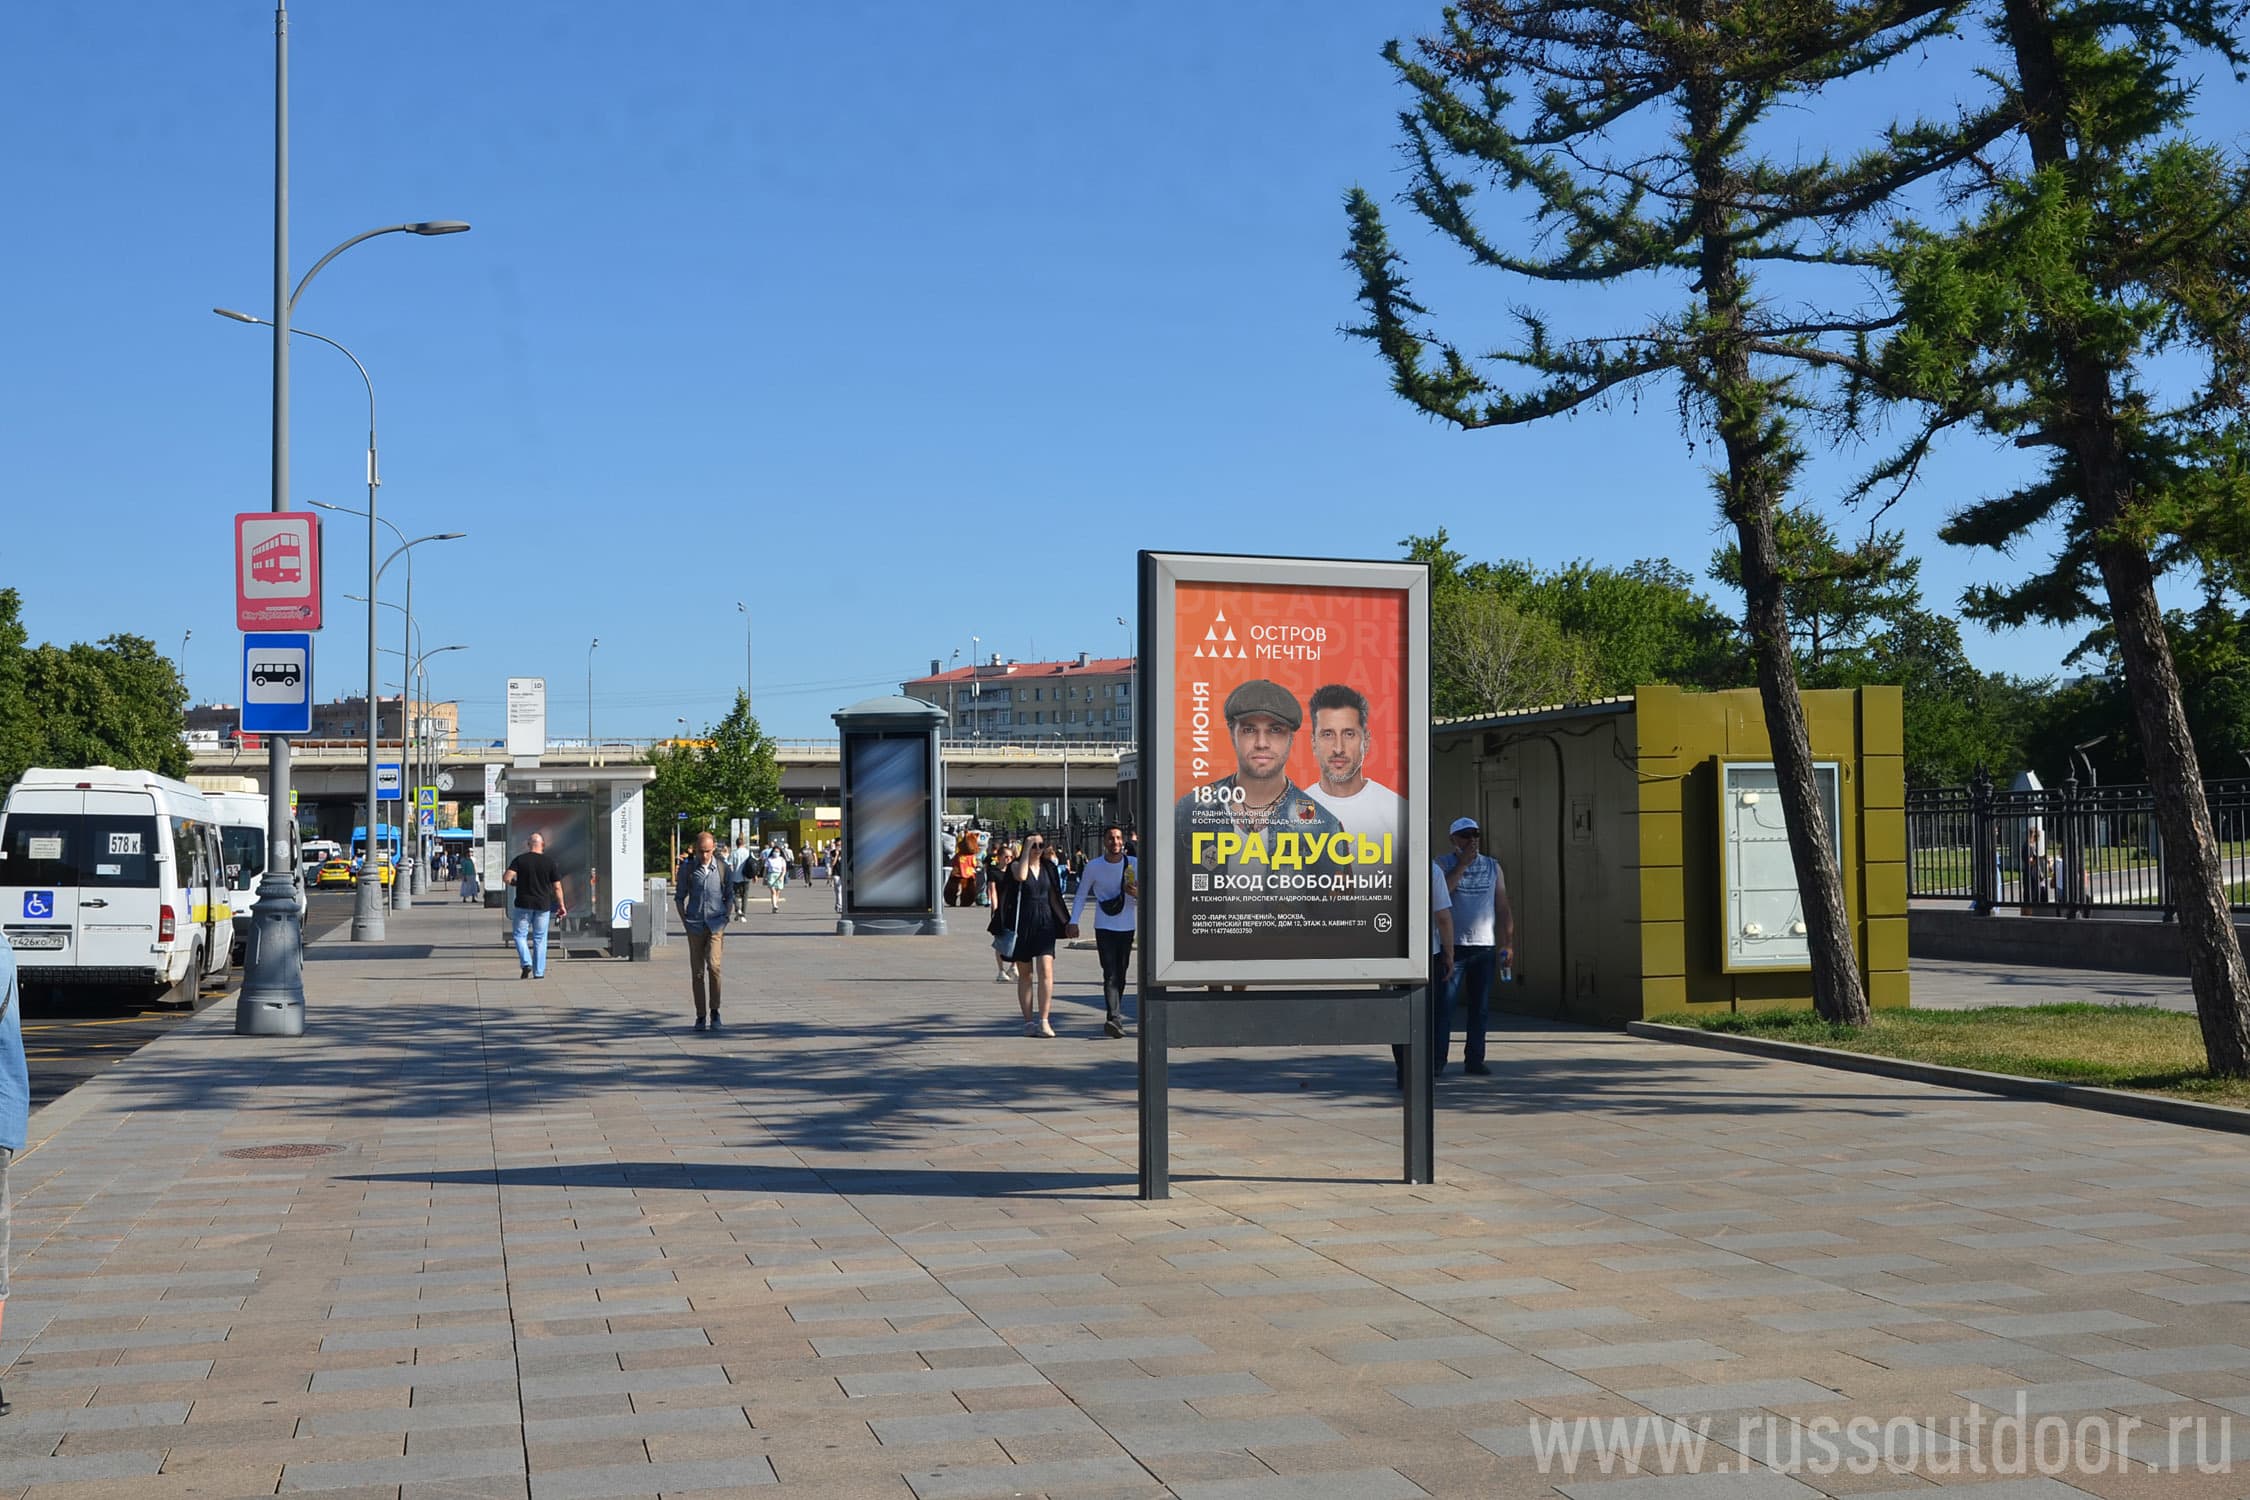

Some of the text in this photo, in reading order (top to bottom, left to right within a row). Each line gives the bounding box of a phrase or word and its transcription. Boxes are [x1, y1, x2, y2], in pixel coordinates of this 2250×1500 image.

[1250, 625, 1327, 642] ОСТРОВ
[1255, 643, 1321, 660] МЕЧТЫ
[1193, 681, 1209, 779] 19 ИЮНЯ
[1192, 786, 1246, 804] 18:00
[1192, 809, 1276, 818] ПРАЗДНИЧНЫЙ КОНЦЕРТ
[1255, 818, 1290, 826] ПЛОЩАДЬ
[111, 836, 130, 853] 578
[1191, 832, 1393, 870] ГРАДУСЫ
[1213, 870, 1393, 891] ВХОД СВОБОДНЫЙ!
[1192, 913, 1207, 921] ООО
[1192, 920, 1241, 928] МИЛЮТИНСКИЙ
[1278, 920, 1293, 928] ДОМ
[1328, 919, 1355, 927] КАБИНЕТ
[1377, 917, 1391, 928] 12+
[1192, 927, 1209, 935] ОГРН
